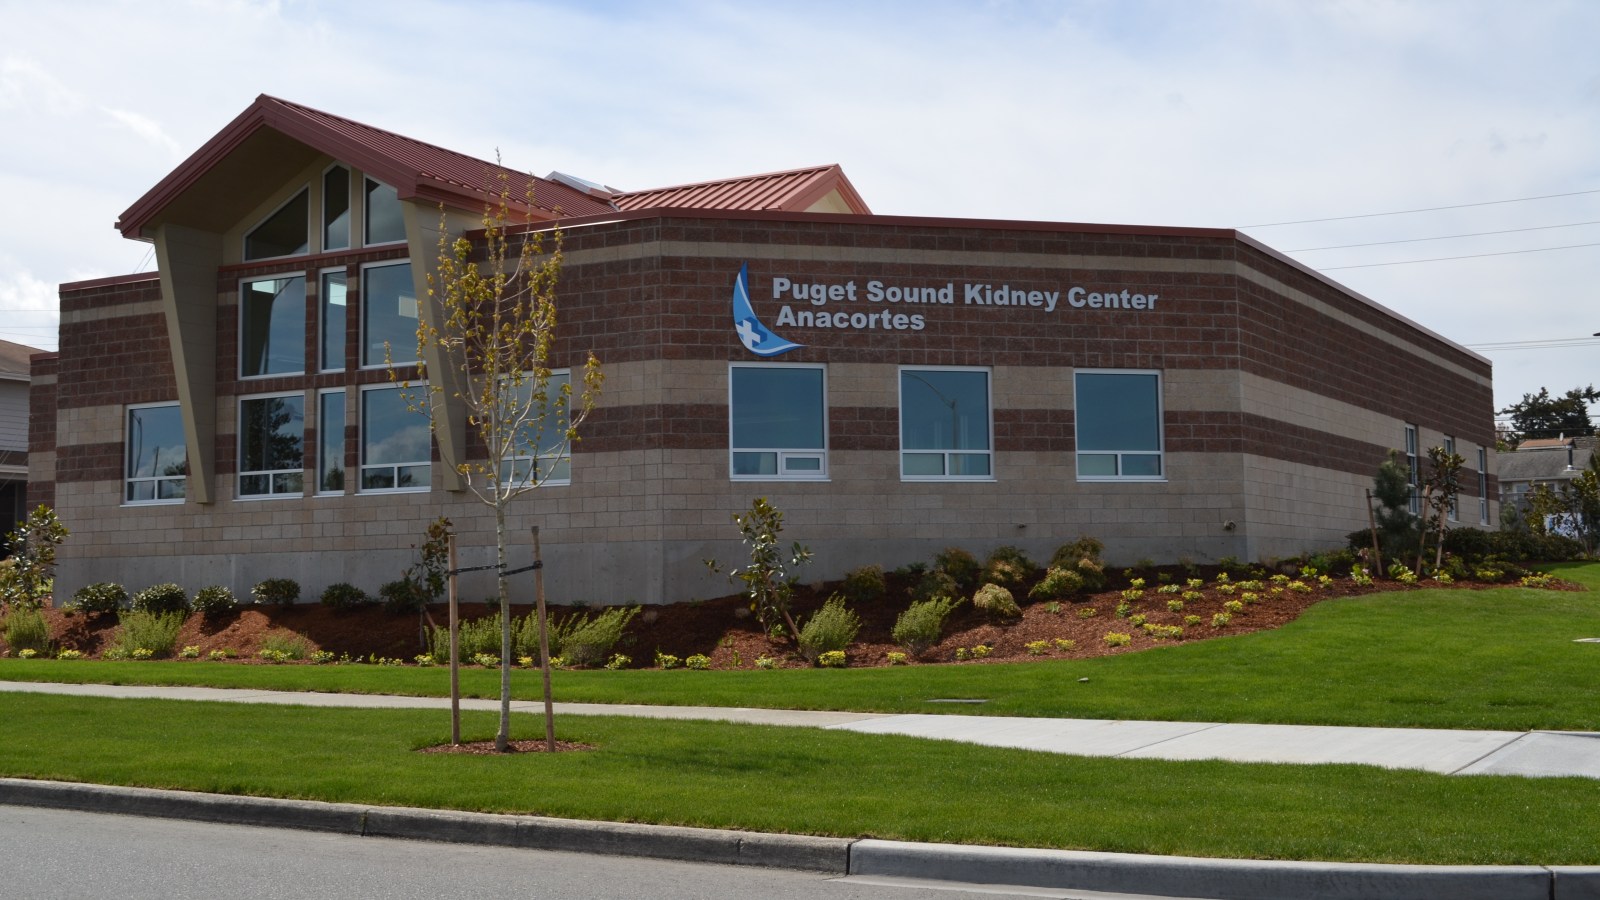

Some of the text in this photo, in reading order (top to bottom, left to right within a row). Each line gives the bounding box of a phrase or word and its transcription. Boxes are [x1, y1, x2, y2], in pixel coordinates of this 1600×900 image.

[772, 277, 1159, 313] Puget Sound Kidney Center
[775, 305, 926, 331] Anacortes
